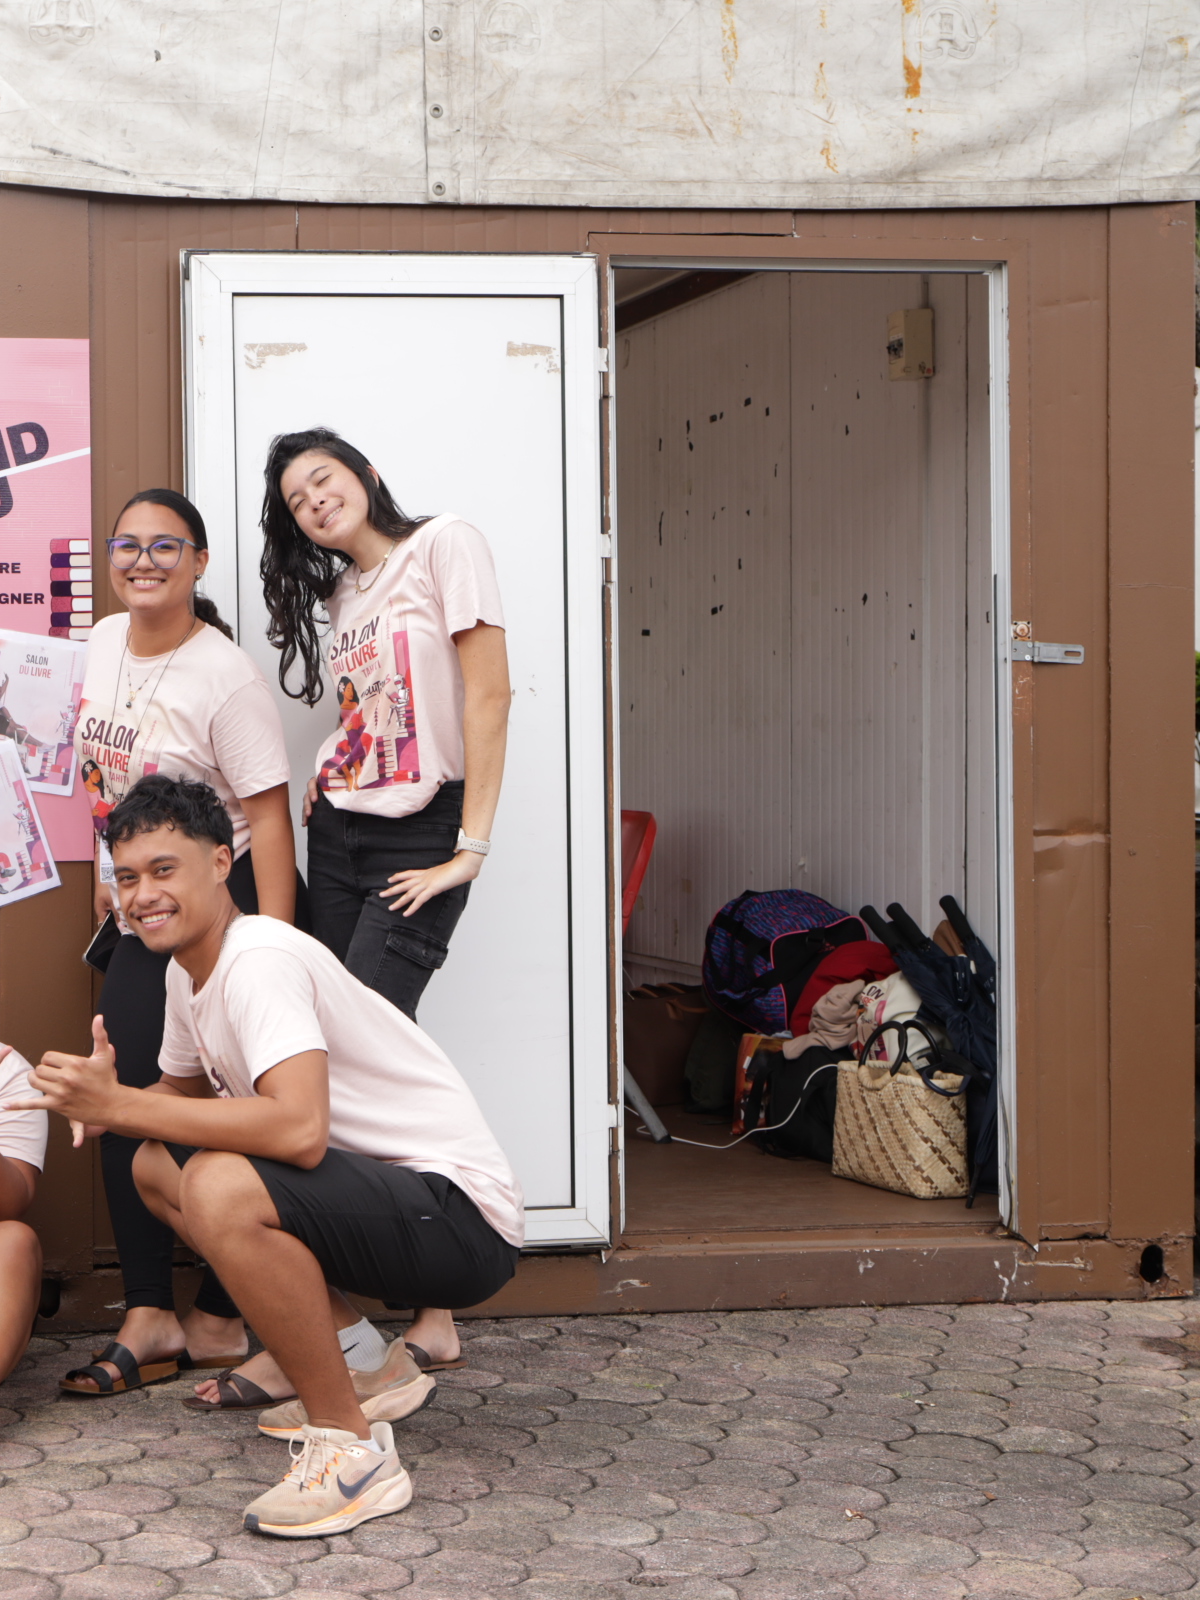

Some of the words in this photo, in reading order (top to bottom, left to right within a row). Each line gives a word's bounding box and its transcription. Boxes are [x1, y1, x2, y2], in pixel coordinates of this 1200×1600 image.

[331, 615, 380, 661] SALON
[19, 664, 30, 675] DU
[31, 666, 52, 678] LIVRE
[26, 653, 49, 666] SALON
[333, 660, 345, 676] DU
[345, 639, 379, 673] LIVRE
[81, 717, 139, 753] SALON
[82, 743, 94, 757] DU
[96, 747, 131, 773] LIVRE
[108, 771, 130, 785] TAHITI
